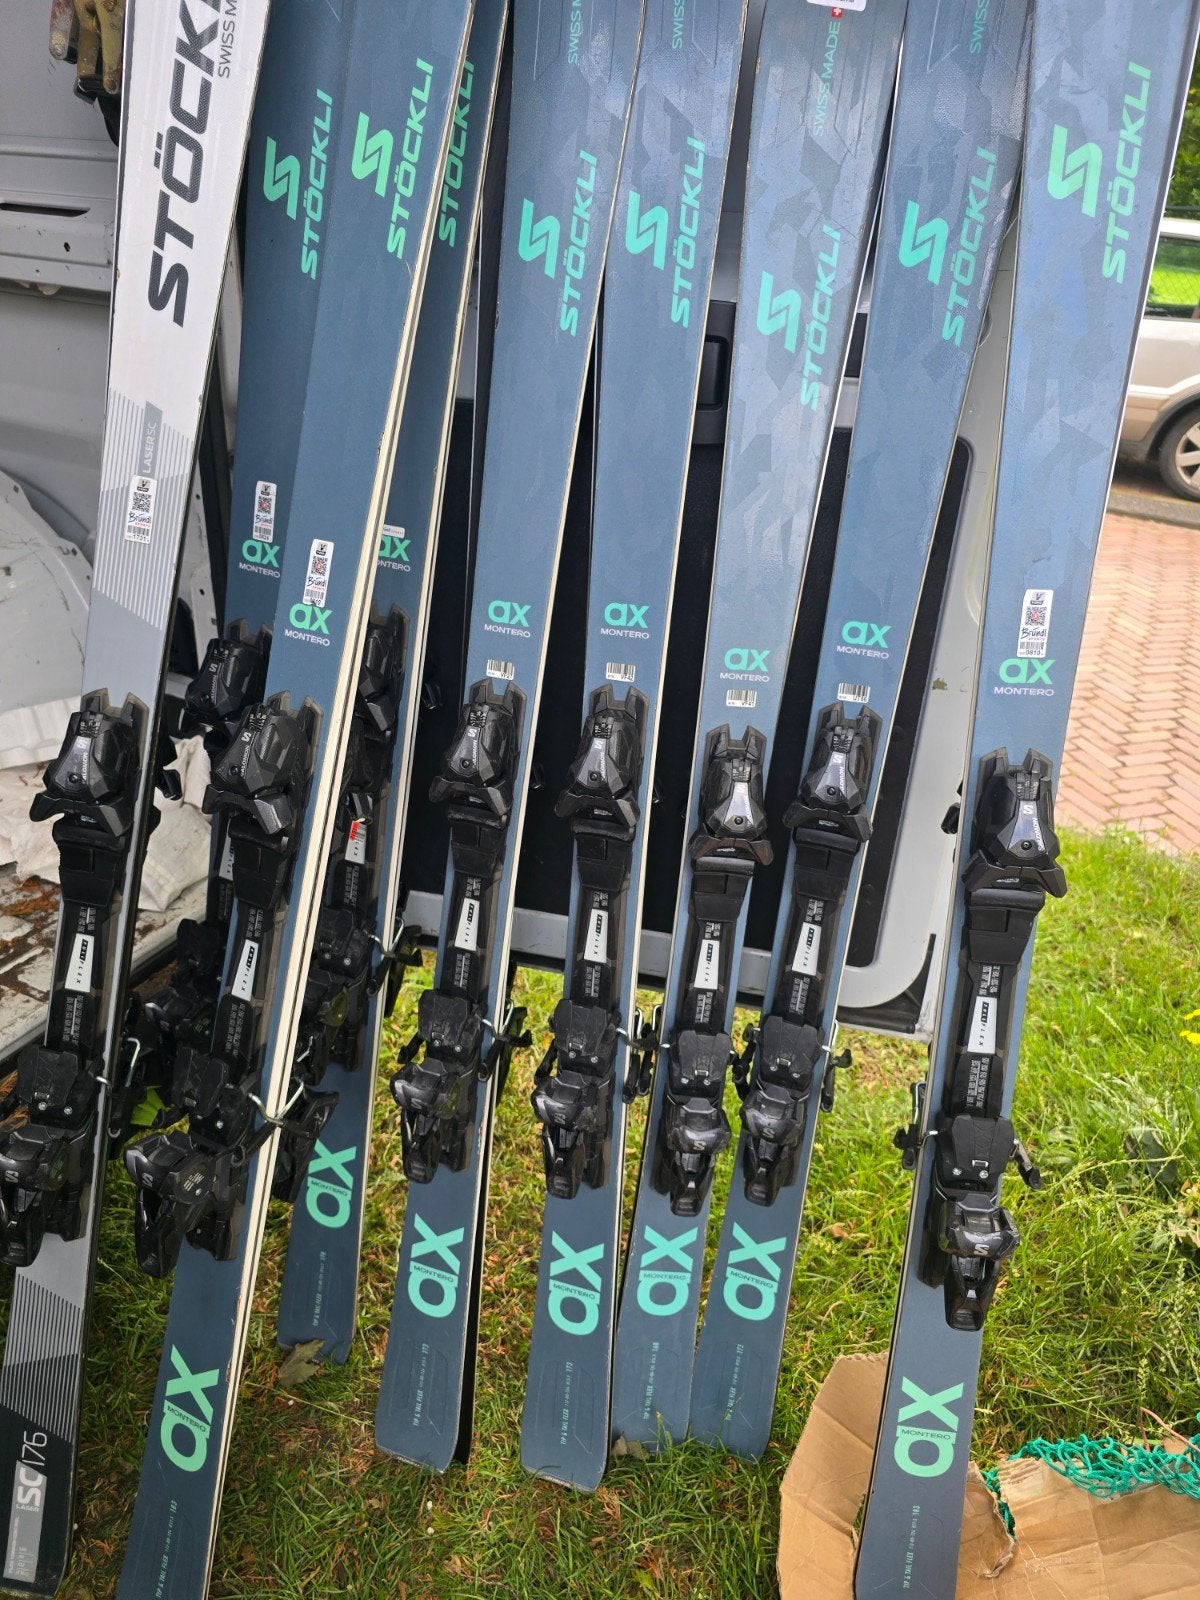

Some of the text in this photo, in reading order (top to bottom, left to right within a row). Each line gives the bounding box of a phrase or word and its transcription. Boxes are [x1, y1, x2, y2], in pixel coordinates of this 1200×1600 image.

[672, 0, 685, 49] SWISS
[970, 0, 990, 54] SWISS
[568, 10, 581, 65] SWISS
[218, 20, 236, 79] SWISS
[813, 22, 841, 137] SWISS MADE
[387, 58, 434, 260] STÖCKLI
[1102, 61, 1152, 284] STÖCKLI
[300, 89, 333, 280] STÖCKLI
[671, 136, 706, 328] STÖCKLI
[560, 150, 598, 337] STÖCKLI
[943, 147, 997, 347] STÖCKLI
[801, 224, 842, 412] STÖCKLI
[239, 562, 281, 578] MONTERO
[376, 560, 411, 572] ONTERO
[284, 629, 330, 646] MONTERO
[484, 623, 531, 638] MONTERO
[600, 628, 650, 640] MONTERO
[836, 645, 890, 660] MONTERO
[719, 672, 770, 683] MONTERO
[994, 686, 1055, 697] MONTERO
[310, 1179, 348, 1198] MONTERO
[412, 1264, 454, 1284] MONTERO
[642, 1271, 687, 1281] MONTERO
[730, 1269, 774, 1289] MONTERO
[553, 1282, 596, 1300] MONTERO
[167, 1405, 207, 1432] MONTERO
[561, 1420, 569, 1431] TAIL
[901, 1427, 951, 1441] MONTERO
[17, 1467, 43, 1506] SC
[161, 1554, 169, 1570] FLEX
[905, 1552, 914, 1563] FLEX
[158, 1570, 167, 1582] TAIL
[904, 1564, 913, 1574] TAIL
[902, 1580, 910, 1589] TIP
